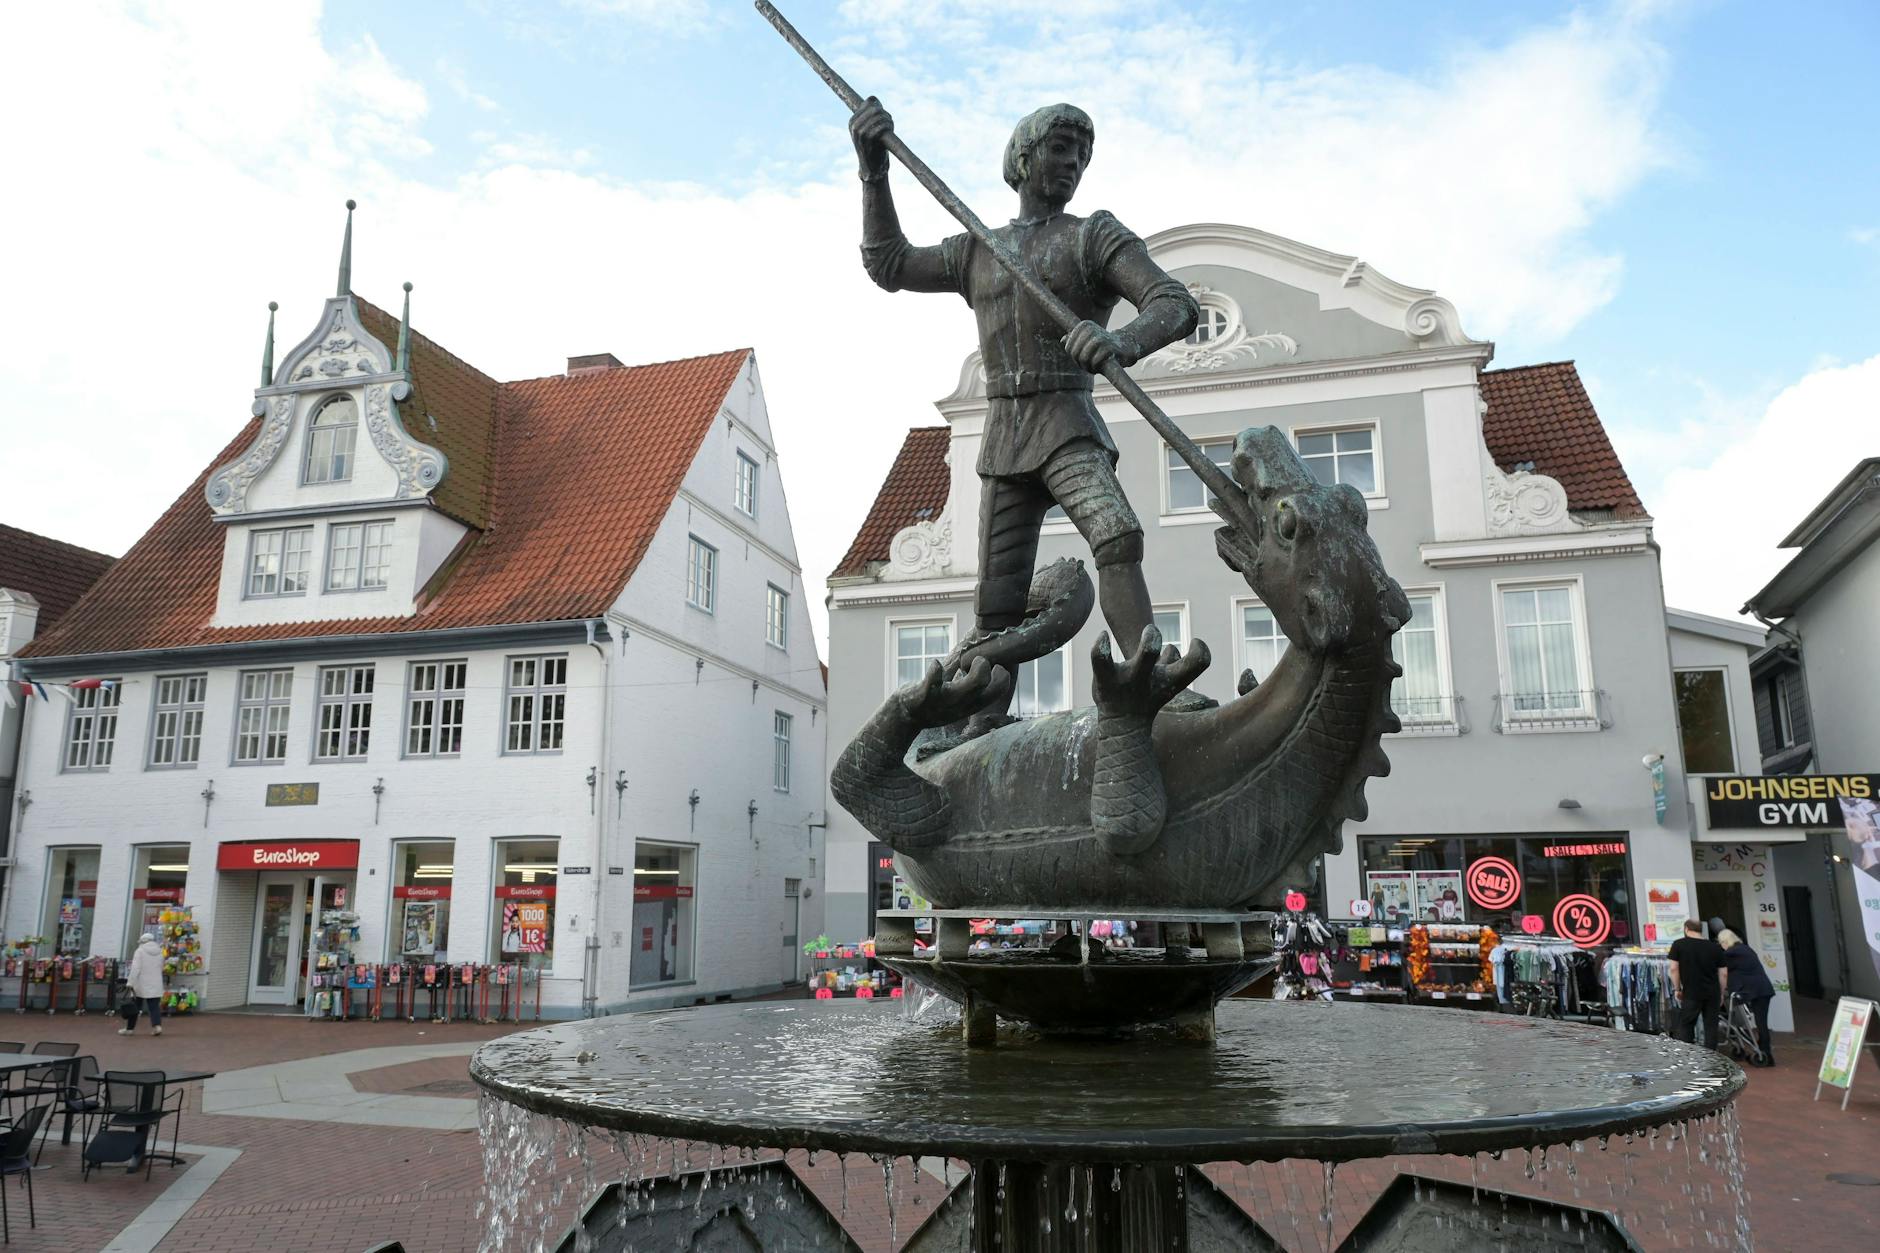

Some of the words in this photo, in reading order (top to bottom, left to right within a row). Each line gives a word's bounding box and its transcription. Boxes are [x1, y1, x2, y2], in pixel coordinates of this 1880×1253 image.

[1710, 776, 1871, 801] JOHNSENS
[1758, 802, 1829, 825] GYM
[253, 847, 320, 867] EuroShop
[1476, 871, 1510, 893] SALE
[520, 909, 545, 921] 1000
[1570, 907, 1592, 929] %
[1760, 903, 1776, 912] 36
[525, 929, 541, 944] 1€
